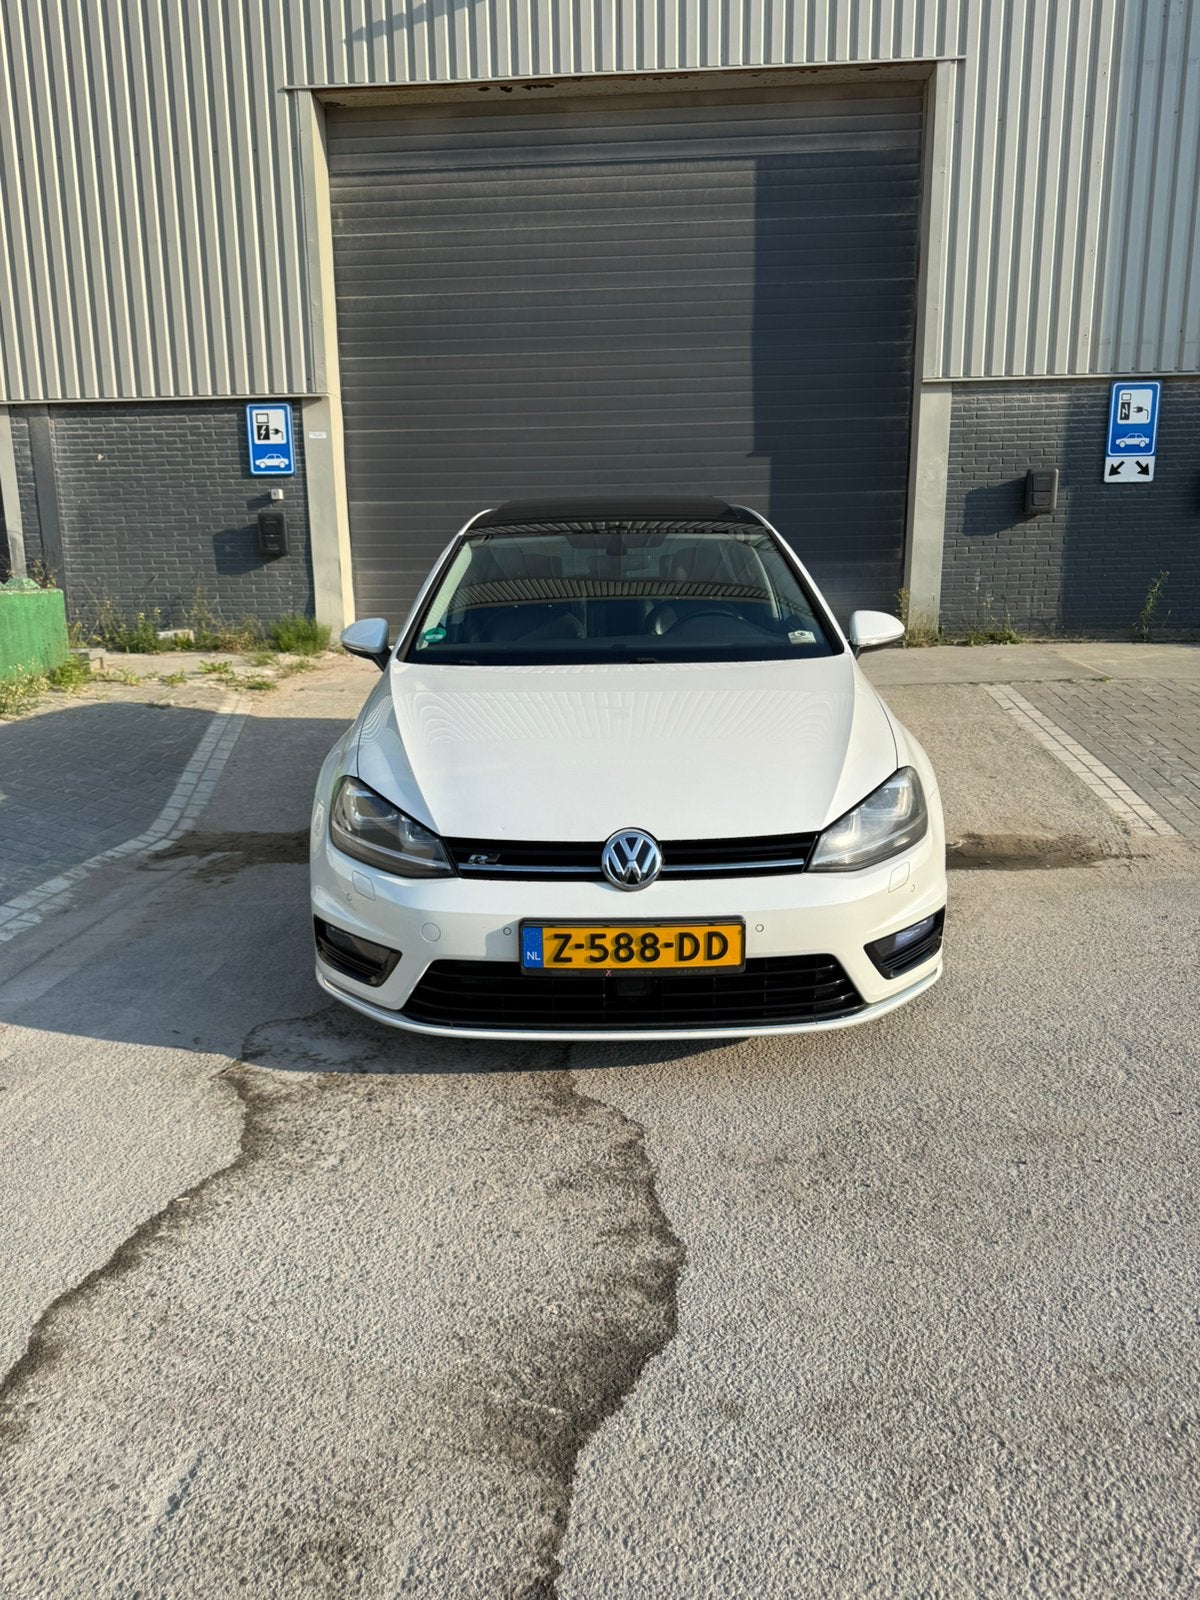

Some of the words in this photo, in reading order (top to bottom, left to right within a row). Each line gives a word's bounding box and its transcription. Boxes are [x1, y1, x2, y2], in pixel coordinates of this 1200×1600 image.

[606, 835, 658, 885] VW
[526, 951, 541, 961] NL
[552, 931, 729, 963] Z-588-DD
